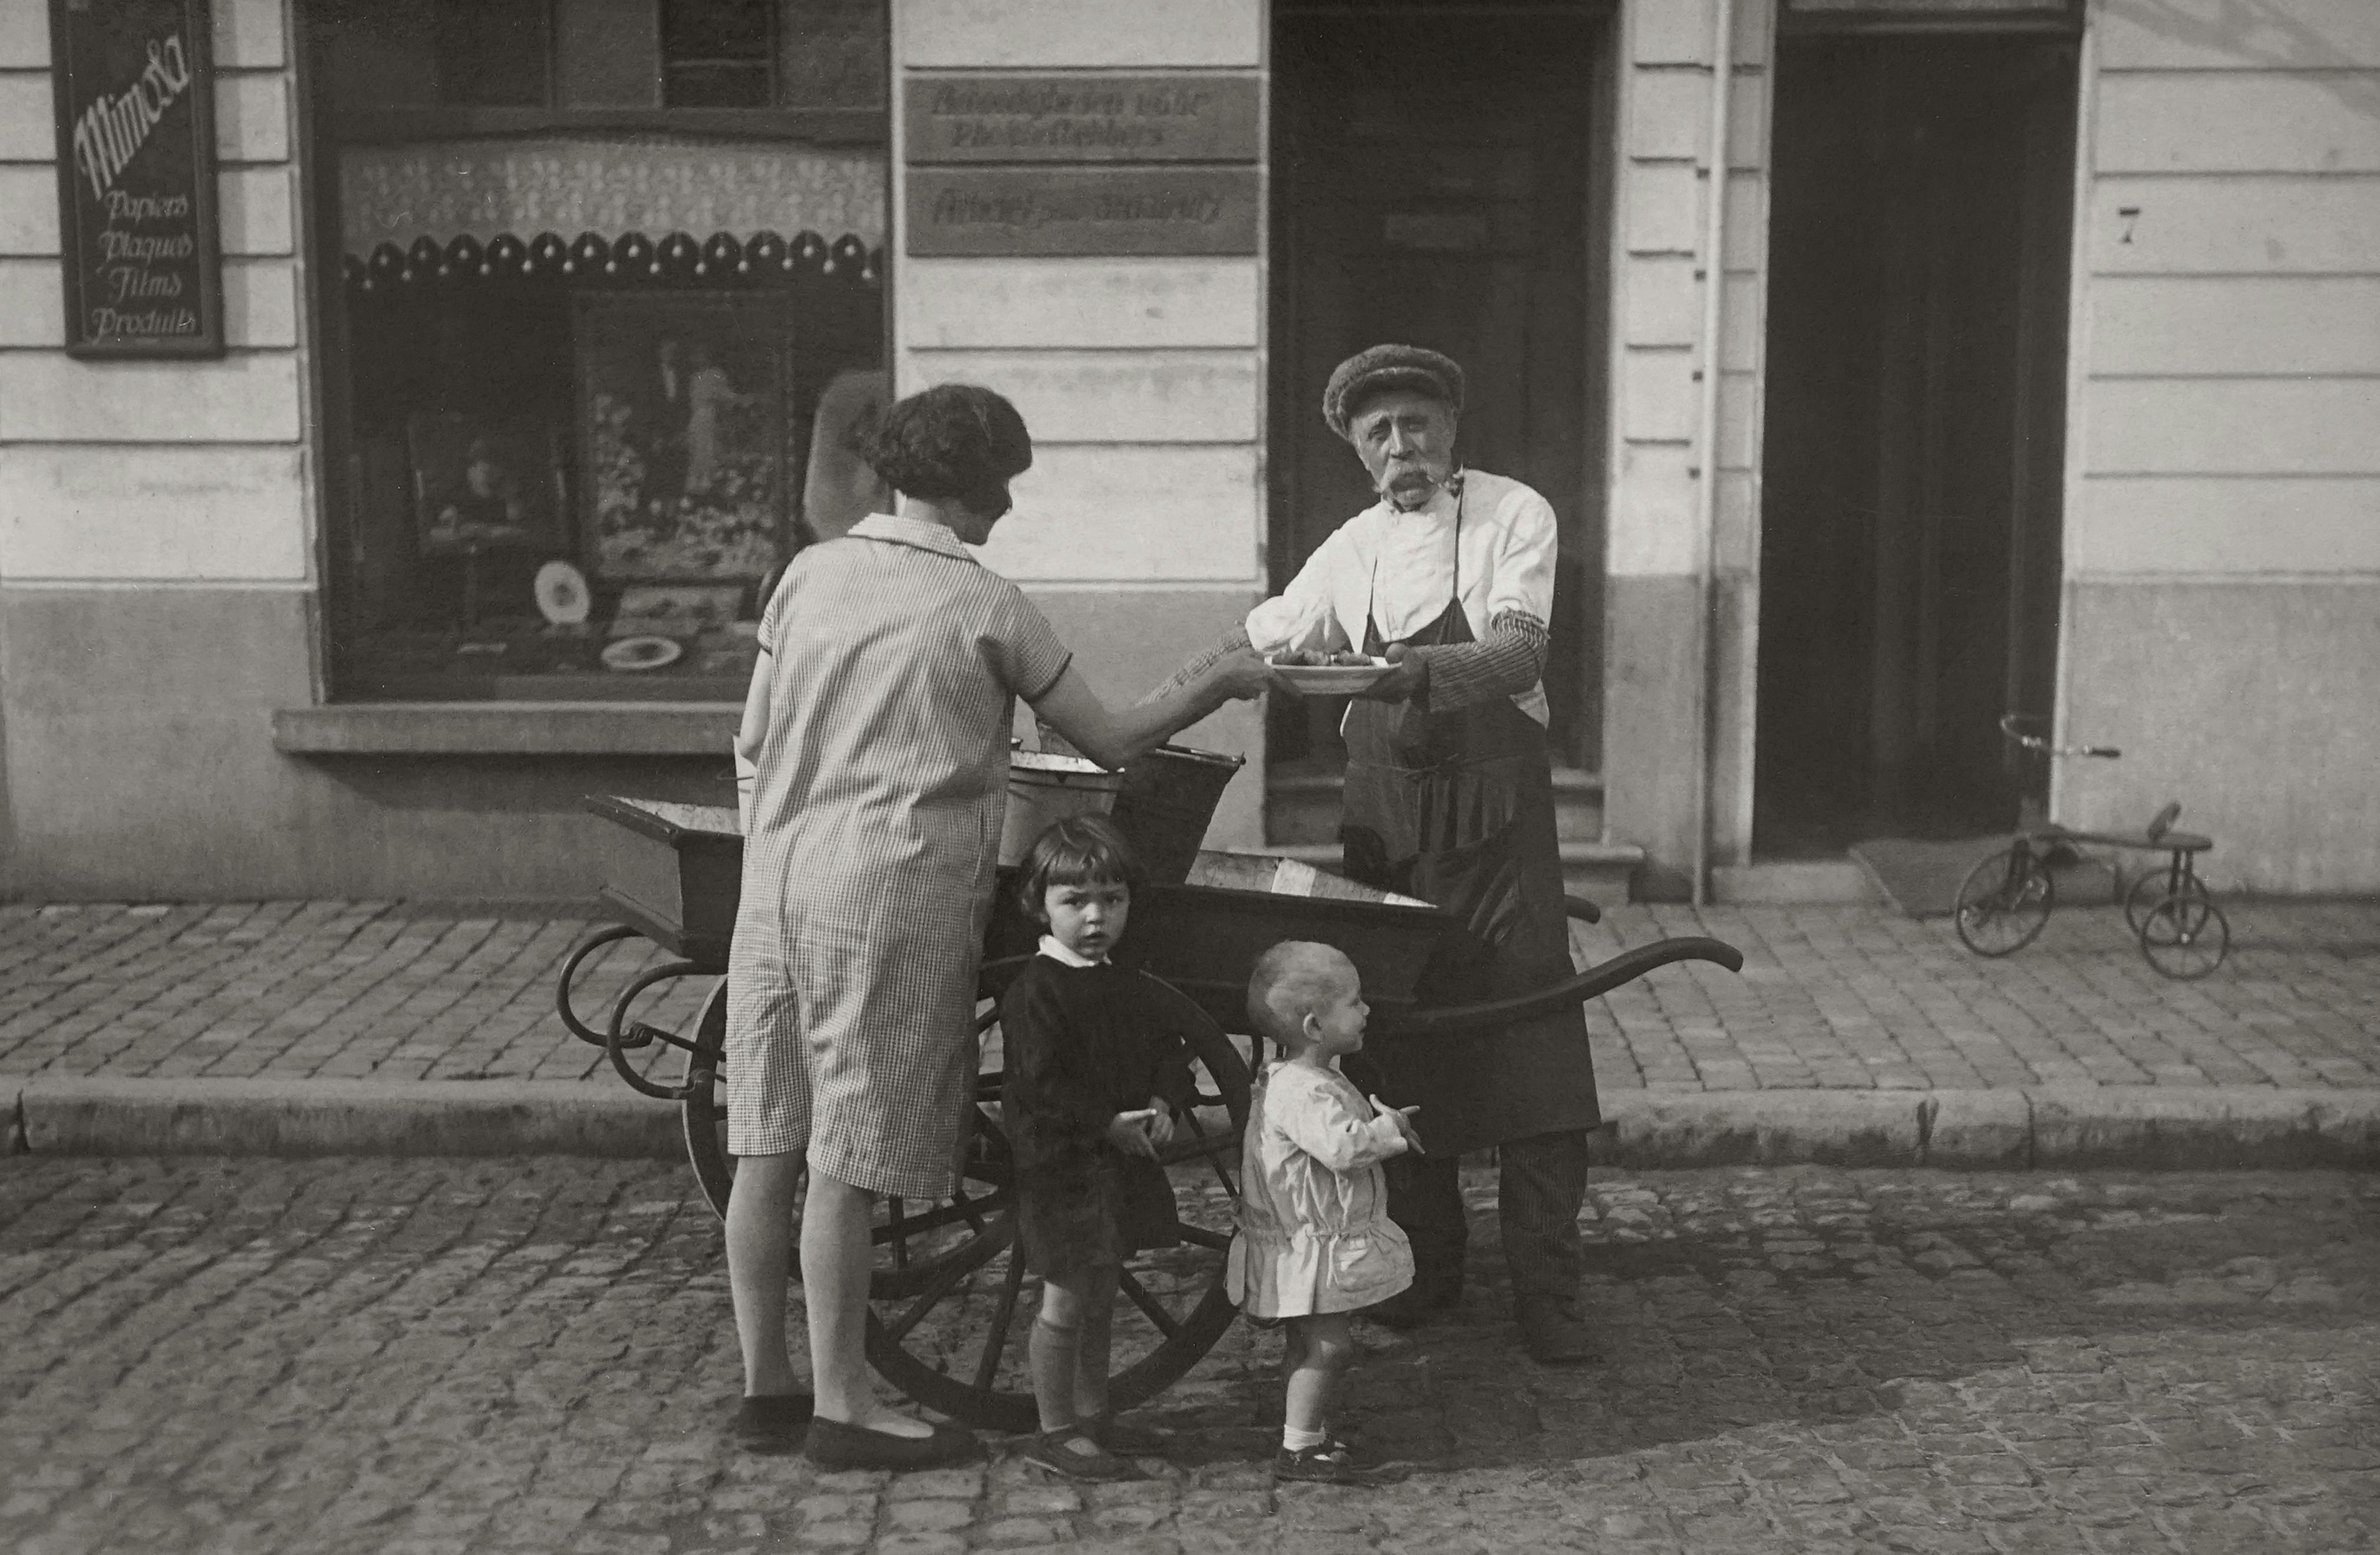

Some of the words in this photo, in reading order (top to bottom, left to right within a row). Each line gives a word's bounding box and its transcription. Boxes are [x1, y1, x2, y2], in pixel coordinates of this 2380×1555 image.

[95, 230, 193, 271] Plaques
[108, 266, 182, 304] Films
[91, 308, 197, 346] Produits
